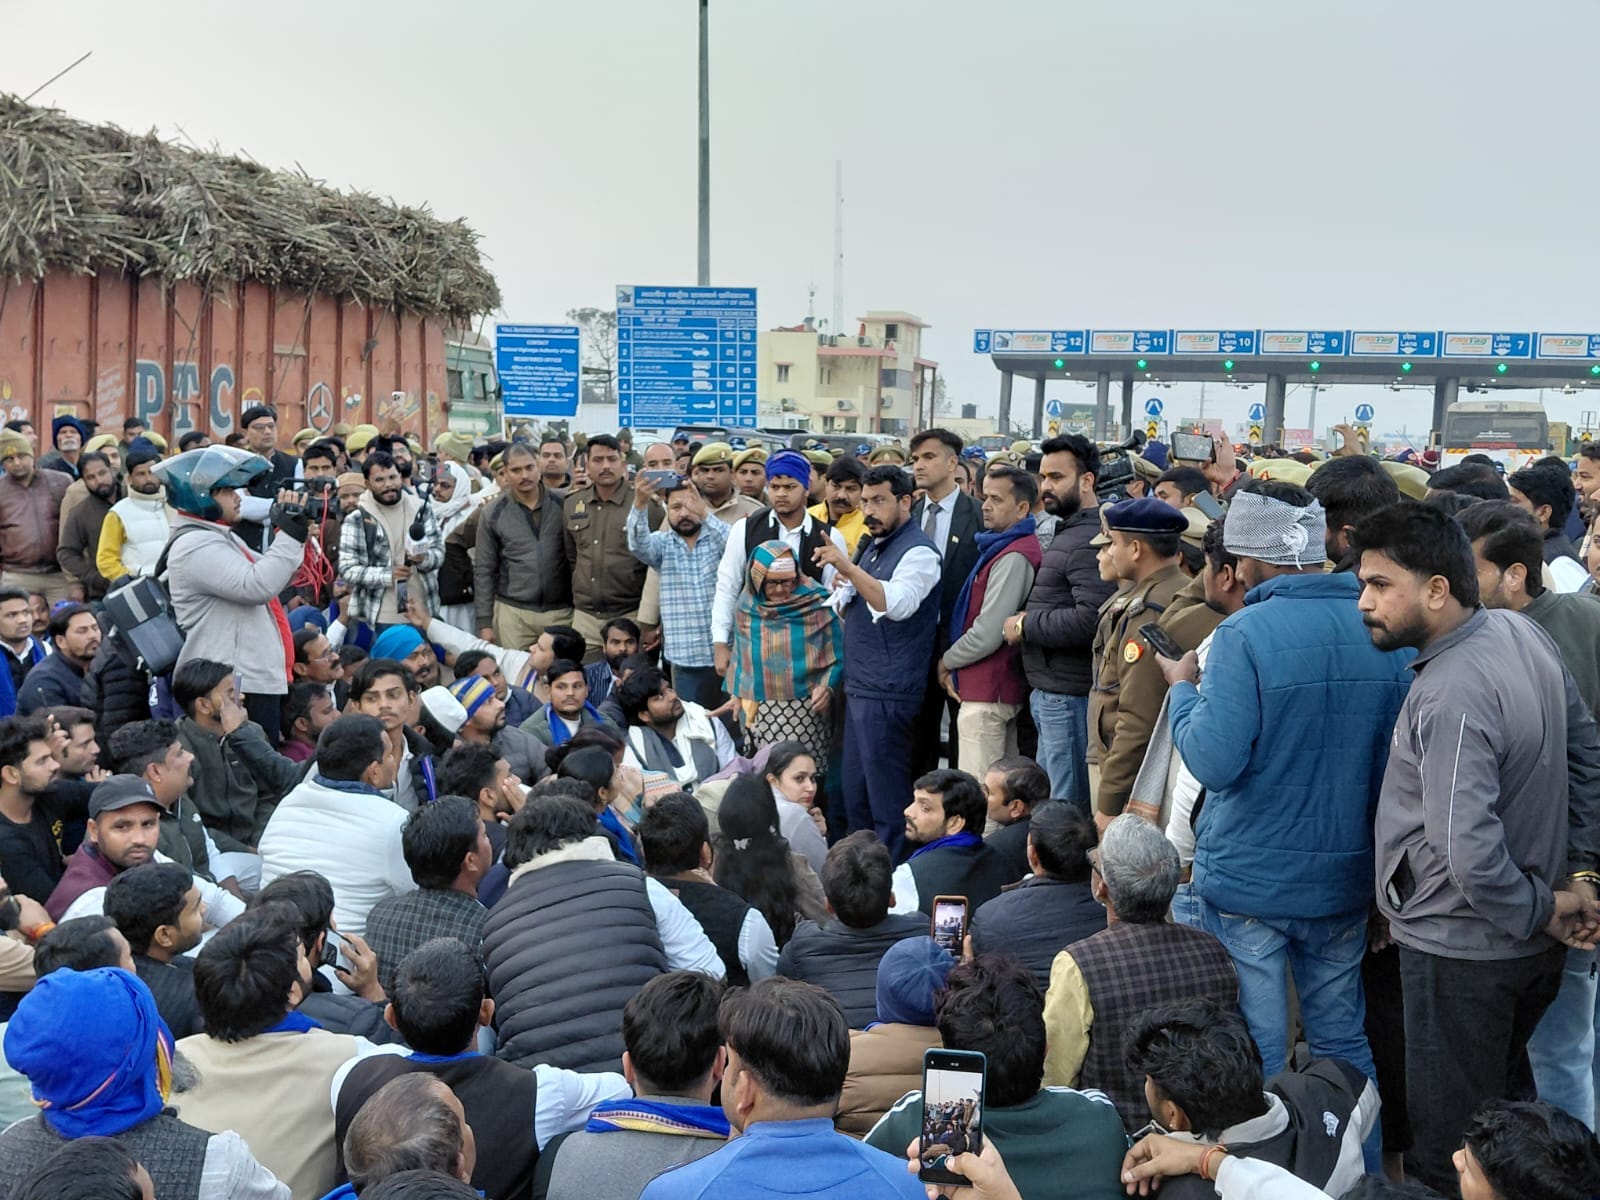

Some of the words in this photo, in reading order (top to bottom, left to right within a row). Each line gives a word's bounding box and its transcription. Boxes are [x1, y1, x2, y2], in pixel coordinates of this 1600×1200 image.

[1069, 337, 1082, 346] 12
[1153, 337, 1163, 346] 11
[1238, 337, 1251, 347] 10
[1517, 340, 1524, 350] 7
[136, 360, 235, 438] PTC
